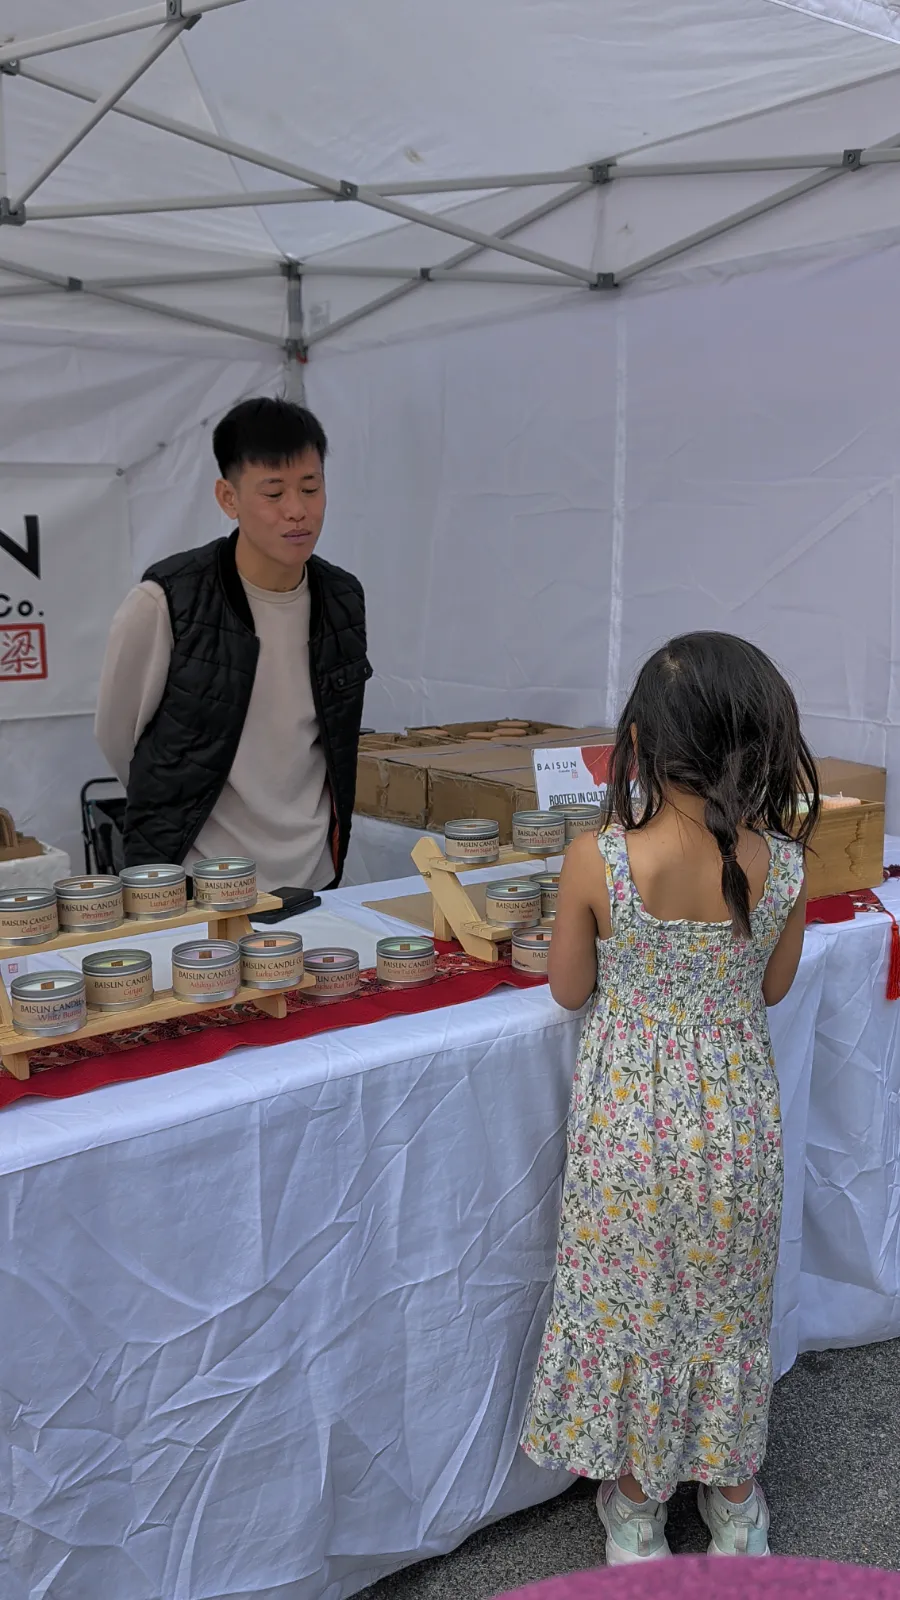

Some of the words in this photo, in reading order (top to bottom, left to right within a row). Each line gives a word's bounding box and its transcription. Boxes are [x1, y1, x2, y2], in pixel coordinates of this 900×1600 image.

[537, 761, 577, 771] BAISUN
[549, 793, 577, 806] ROOTED
[578, 792, 587, 803] IN
[569, 819, 591, 827] BAISUN
[517, 829, 538, 837] BAISUN
[204, 882, 232, 890] BAISUN
[131, 891, 161, 900] BAISUN
[60, 902, 89, 912] BAISUN
[90, 898, 119, 911] CANDLE
[496, 901, 520, 910] BAISUN
[2, 918, 28, 927] BAISUN
[243, 960, 266, 970] BAISUN
[267, 957, 296, 970] CANDLE
[383, 960, 406, 969] BAISUN
[178, 970, 206, 980] BAISUN
[207, 967, 236, 980] CANDLE
[94, 981, 124, 989] BAISUN
[20, 1004, 51, 1014] BAISUN
[37, 1011, 61, 1021] White
